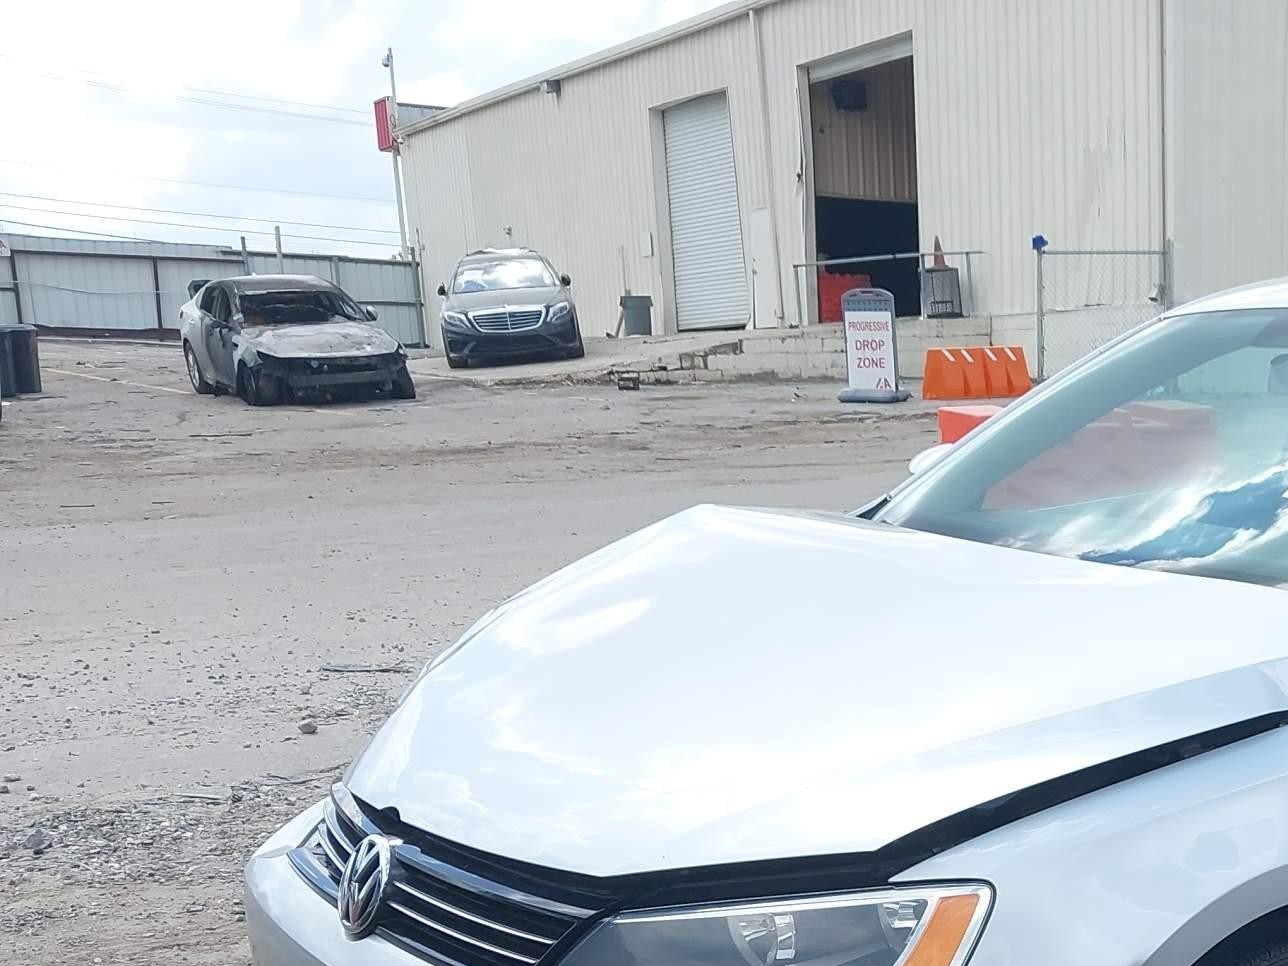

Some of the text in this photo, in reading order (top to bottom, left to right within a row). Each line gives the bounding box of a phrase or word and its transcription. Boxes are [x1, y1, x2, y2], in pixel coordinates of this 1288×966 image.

[848, 321, 891, 332] PROGRESSIVE
[855, 340, 886, 351] DROP
[857, 358, 886, 369] ZONE
